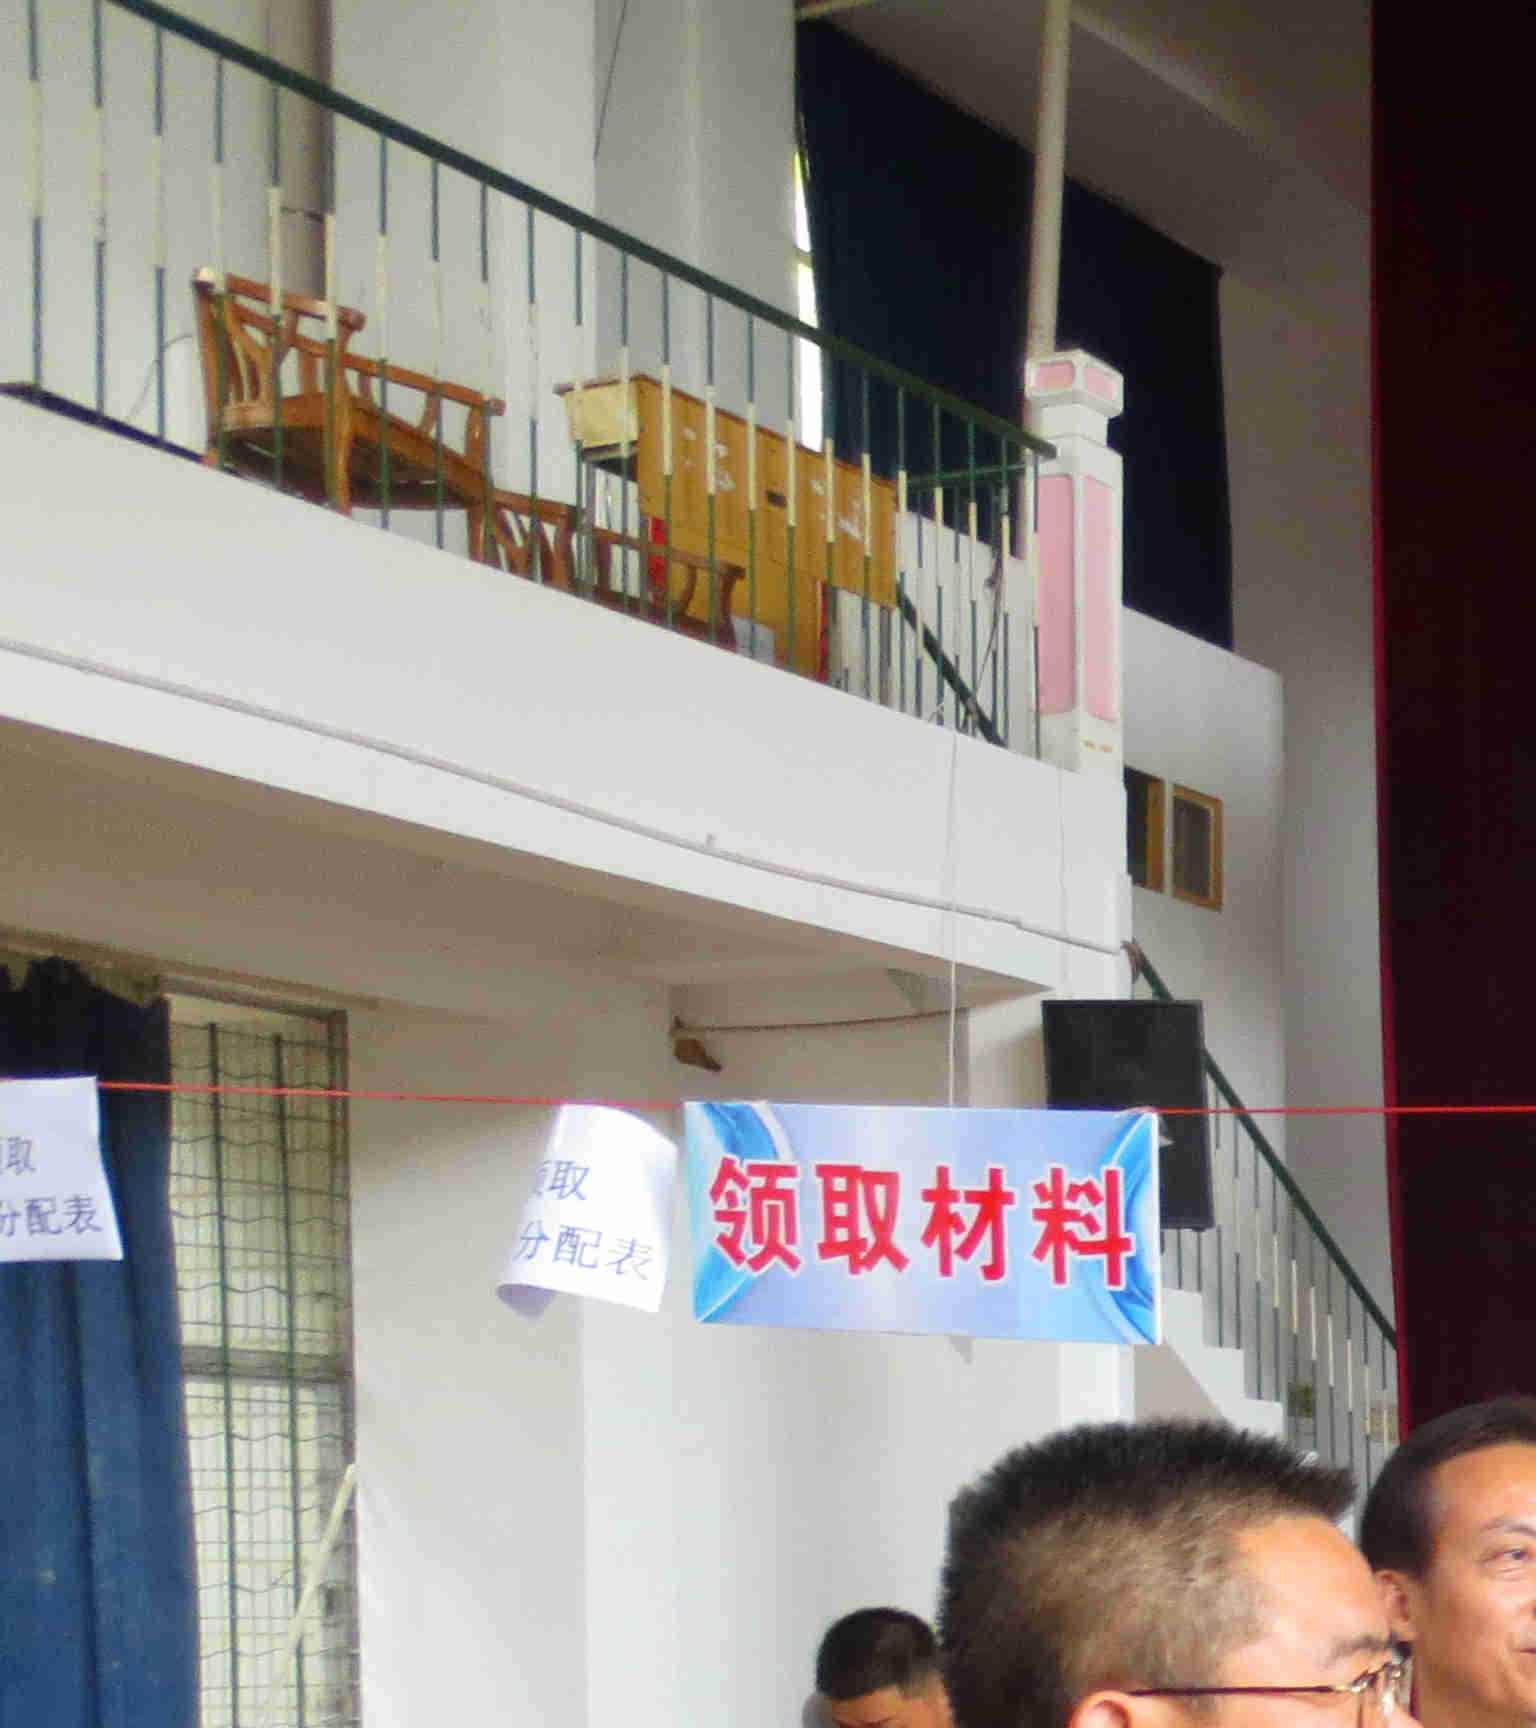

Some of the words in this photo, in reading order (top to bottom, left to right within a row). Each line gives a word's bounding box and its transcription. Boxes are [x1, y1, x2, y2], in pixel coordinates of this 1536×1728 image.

[0, 1136, 36, 1176] 取
[710, 1156, 1133, 1288] 领取材料
